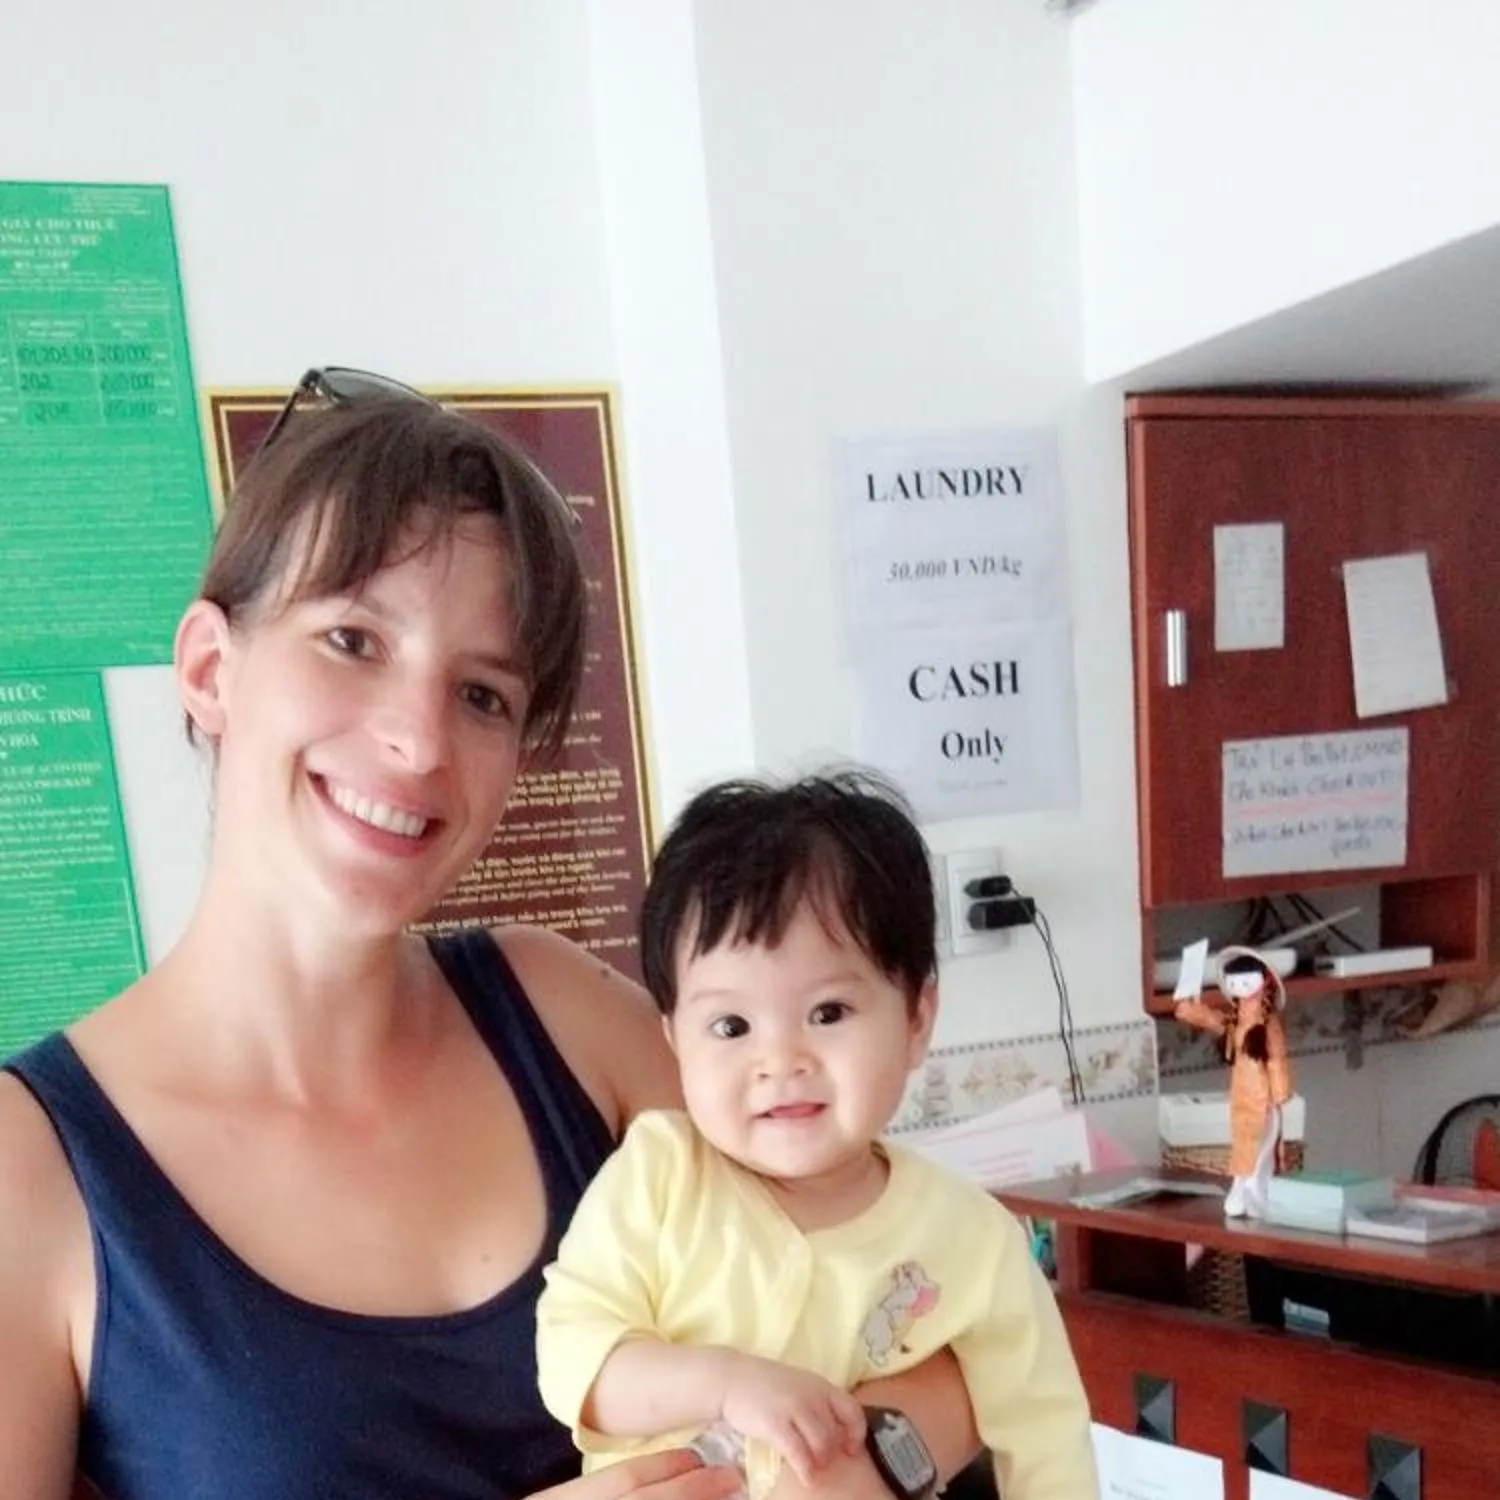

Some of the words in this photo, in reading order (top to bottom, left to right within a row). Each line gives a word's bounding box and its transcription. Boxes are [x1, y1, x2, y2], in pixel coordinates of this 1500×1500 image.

[867, 465, 1029, 502] LAUNDRY
[908, 660, 1021, 703] CASH
[940, 726, 1008, 764] Only
